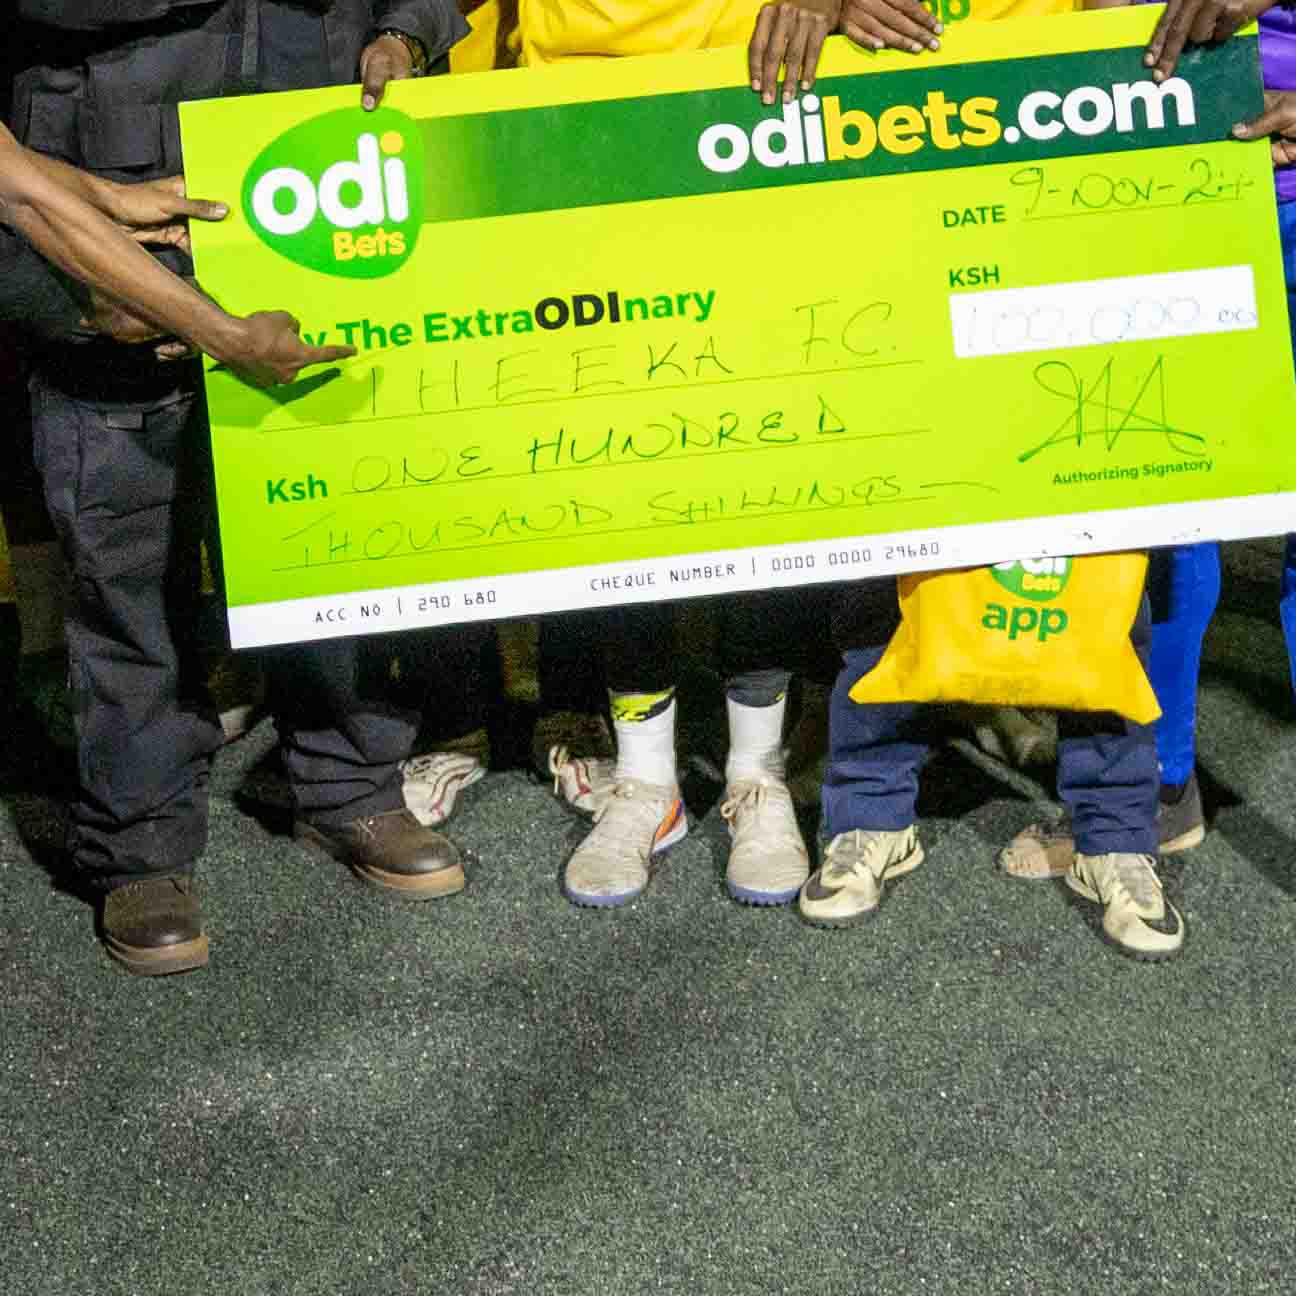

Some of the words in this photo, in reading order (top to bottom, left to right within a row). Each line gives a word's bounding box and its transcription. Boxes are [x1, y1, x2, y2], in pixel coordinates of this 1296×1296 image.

[697, 77, 1197, 173] odibets.com
[252, 131, 410, 236] odi
[942, 204, 1007, 229] DATE
[331, 227, 406, 262] Bets
[949, 265, 1001, 288] KSH
[335, 319, 413, 350] The
[423, 288, 716, 344] ExtraODInary
[352, 445, 493, 493] ONE
[528, 394, 848, 473] HUNDRED
[266, 474, 329, 504] Ksh
[1053, 462, 1140, 485] Authorizing
[1142, 459, 1214, 481] Signatory
[282, 499, 614, 568] THOUSAND
[315, 607, 348, 624] ACC
[360, 602, 383, 618] NO
[417, 595, 451, 611] 290
[590, 572, 657, 592] CHEQUE
[669, 563, 736, 583] NUMBER
[770, 553, 816, 571] 0000
[828, 548, 873, 565] 0000
[981, 603, 1069, 641] app
